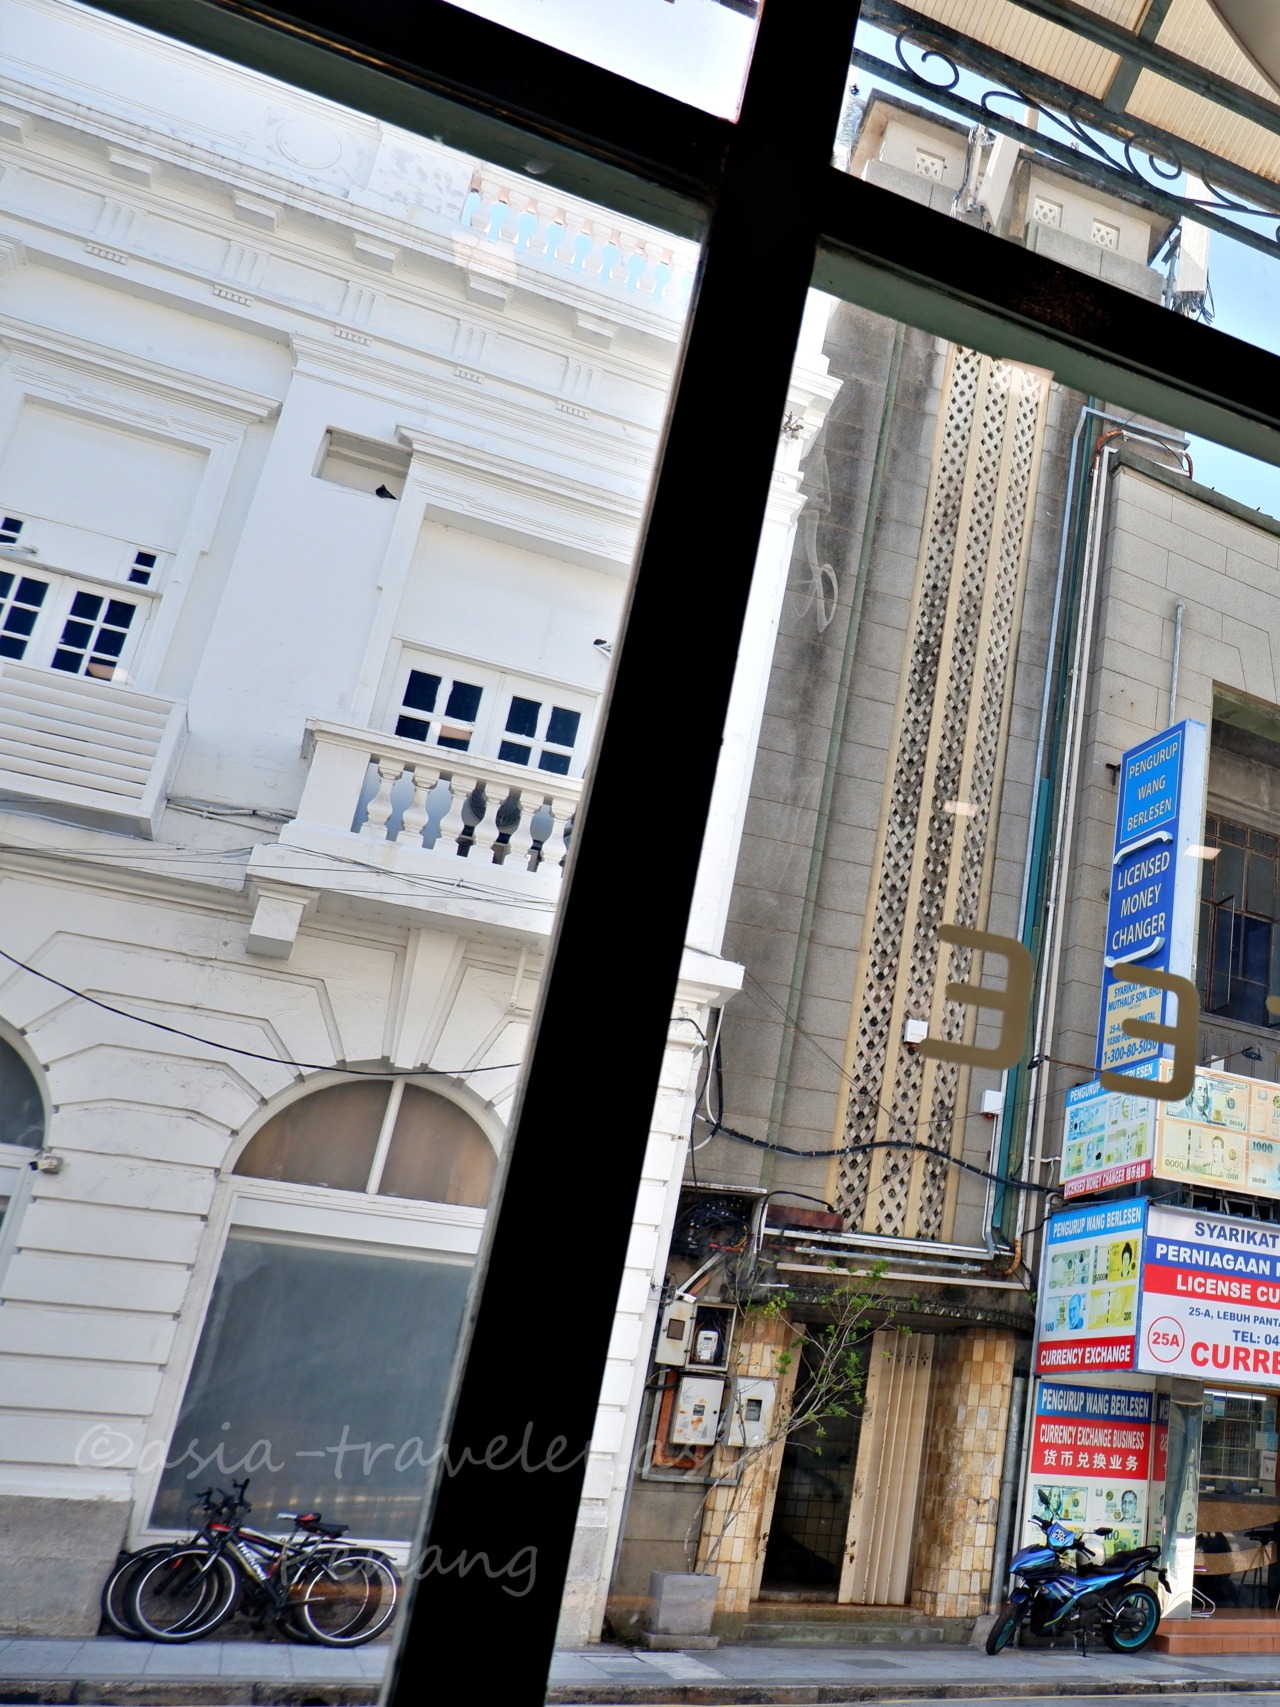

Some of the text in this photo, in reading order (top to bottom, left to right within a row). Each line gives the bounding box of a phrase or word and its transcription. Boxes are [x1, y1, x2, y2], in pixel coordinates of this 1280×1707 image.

[1128, 741, 1179, 780] PENGURUP
[1138, 774, 1167, 801] WANG
[1126, 798, 1172, 832] BERLESEN
[1117, 851, 1171, 891] LICENSED
[1120, 882, 1163, 919] MONEY
[1111, 911, 1167, 951] CHANGER
[1053, 1206, 1142, 1239] PENGURUP WANG BERLESEN
[1194, 1221, 1280, 1249] SYARIKAT
[1155, 1243, 1270, 1276] PERNIAGAAN
[1176, 1273, 1252, 1300] LICENSE
[1188, 1306, 1214, 1321] 25-A,
[1216, 1310, 1251, 1324] LEBUH
[1152, 1331, 1180, 1348] 25A
[1232, 1329, 1261, 1344] TEL:
[1040, 1344, 1131, 1367] CURRENCY EXCHANGE
[1041, 1388, 1085, 1413] PENGURUP
[1086, 1395, 1109, 1415] WANG
[1110, 1395, 1150, 1419] BERLESEN
[1040, 1423, 1077, 1445] CURRENCY
[1077, 1426, 1112, 1448] EXCHANGE
[1113, 1429, 1145, 1451] BUSINESS
[1043, 1448, 1139, 1472] 货币兑换业务
